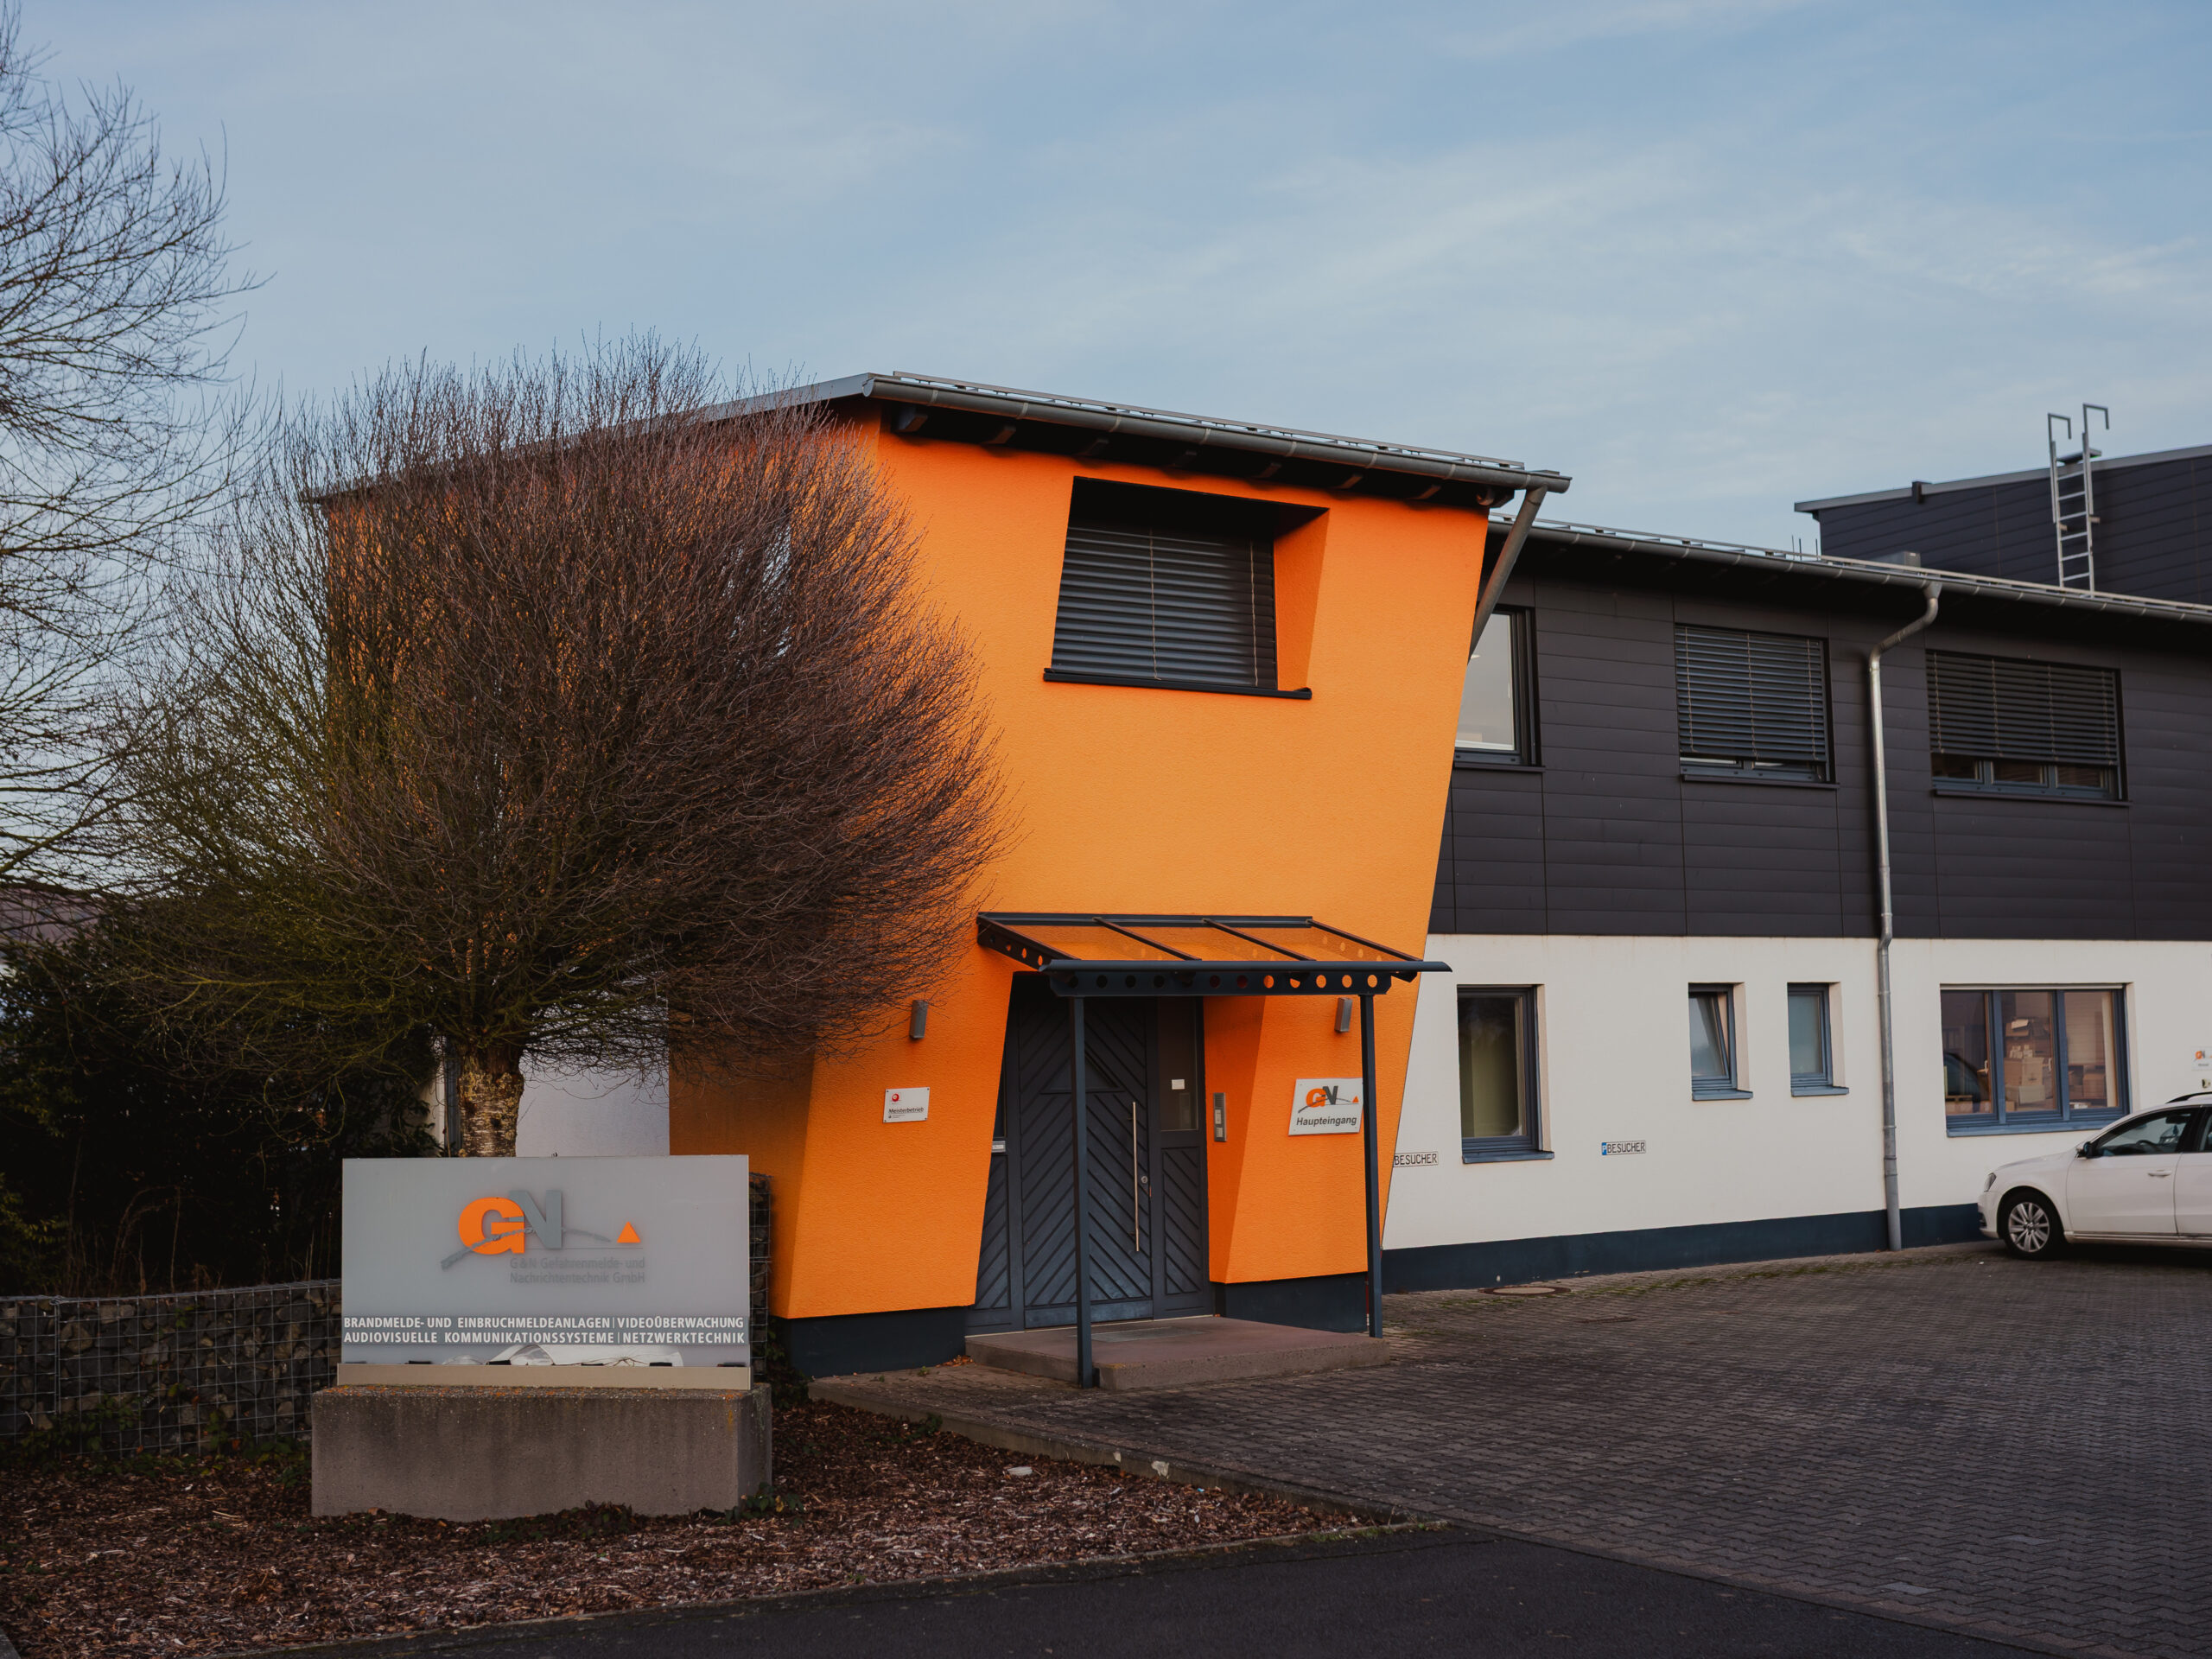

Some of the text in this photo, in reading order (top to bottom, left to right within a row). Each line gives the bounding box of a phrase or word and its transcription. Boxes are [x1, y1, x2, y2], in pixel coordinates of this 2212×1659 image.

[1296, 1116, 1357, 1127] Haupteingang
[1607, 1142, 1645, 1154] BESUCHER
[1394, 1154, 1437, 1166] BESUCHER
[625, 1257, 645, 1268] und
[510, 1272, 645, 1283] Nachrichtentechnik GmbH
[344, 1316, 744, 1328] BRANDMELDE- UND EINBRUCHMELDEANLAGEN VIDEOÜBERWACHUNG
[344, 1332, 745, 1343] AUDIOVISUELLE KOMMUNIKATIONSSYSTEME NETZWERKTECHNIK
